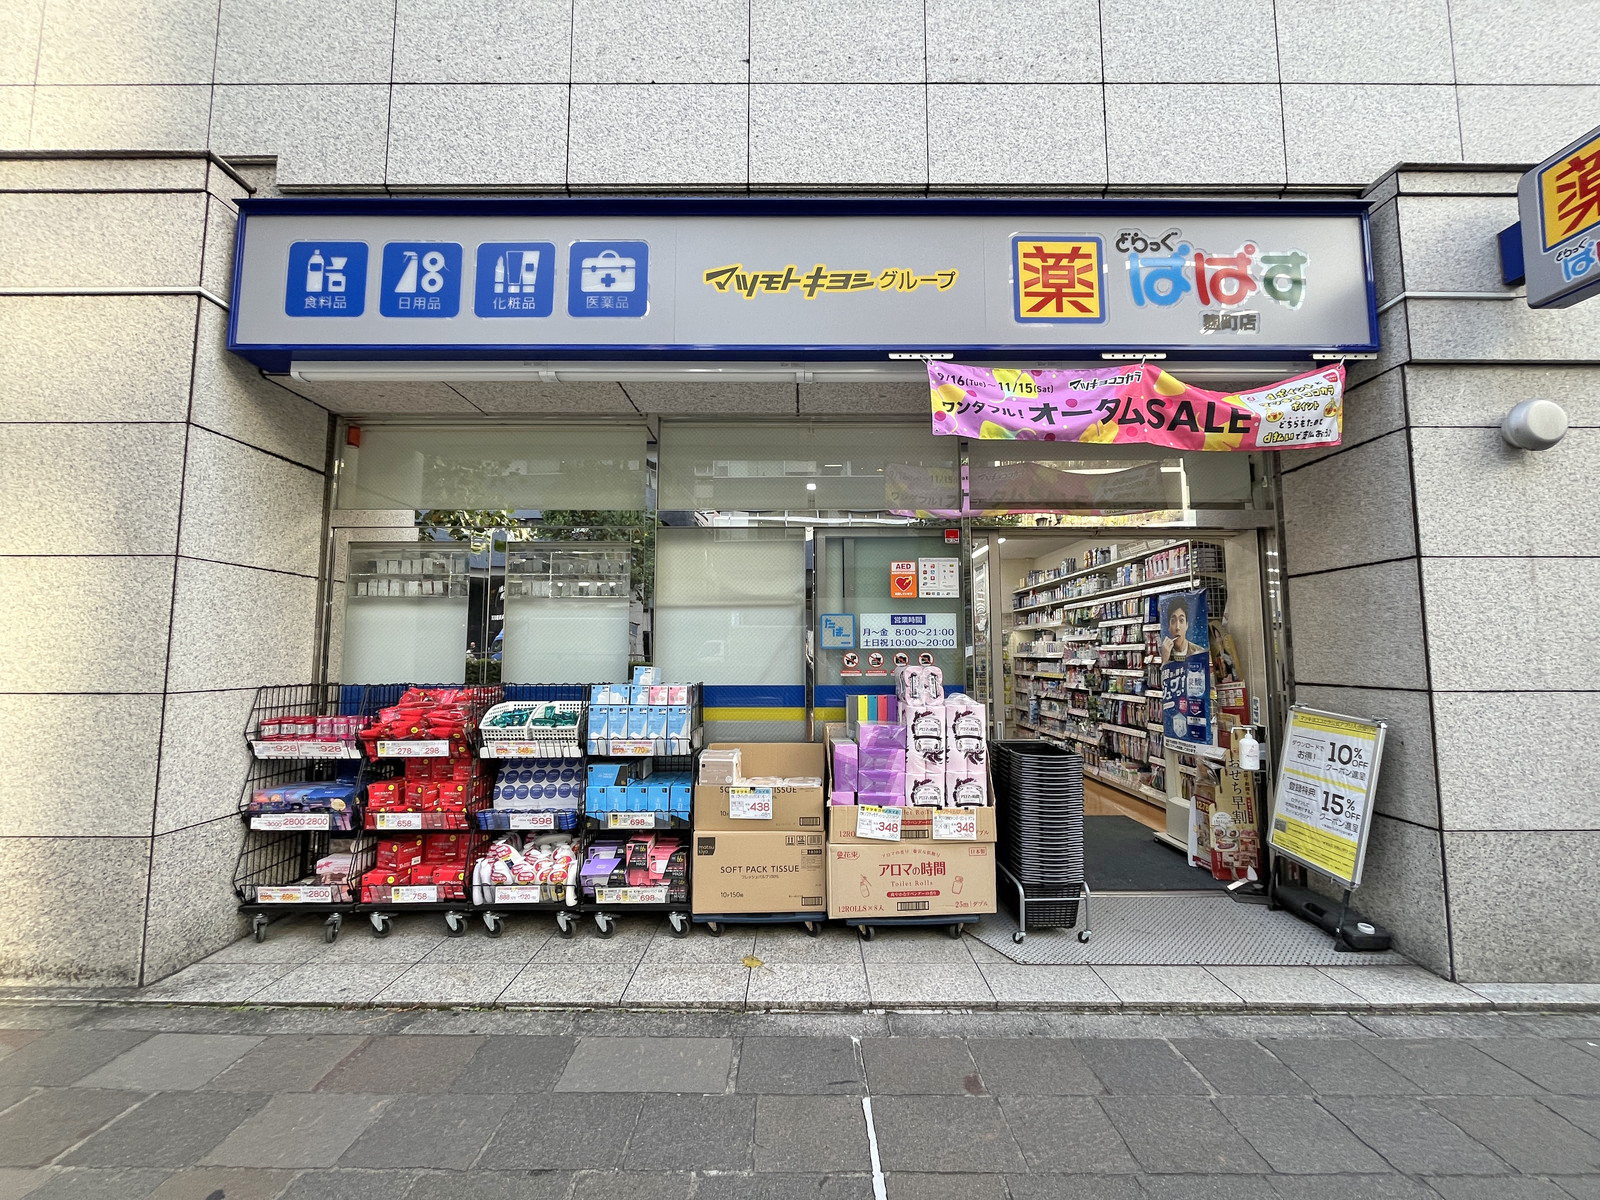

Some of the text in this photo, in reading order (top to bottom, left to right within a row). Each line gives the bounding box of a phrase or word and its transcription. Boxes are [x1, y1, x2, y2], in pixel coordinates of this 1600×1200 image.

[1116, 232, 1178, 253] どらっぐ
[1023, 246, 1094, 313] 薬
[1129, 244, 1307, 307] ぱぱす
[303, 296, 347, 310] 食料品
[398, 297, 441, 310] 日用品
[492, 297, 535, 310] 化粧品
[586, 296, 629, 310] 医薬品
[1291, 401, 1320, 412] ポイント
[1352, 759, 1369, 769] OFF
[750, 802, 770, 812] 438
[306, 817, 328, 825] 2800
[531, 817, 553, 825] 598
[1344, 811, 1361, 822] OFF
[878, 821, 899, 833] 348
[956, 822, 975, 833] 348
[746, 865, 768, 873] PACK
[771, 865, 800, 873] TISSUE
[879, 861, 946, 877] アロマの時間
[890, 880, 912, 888] Toilet
